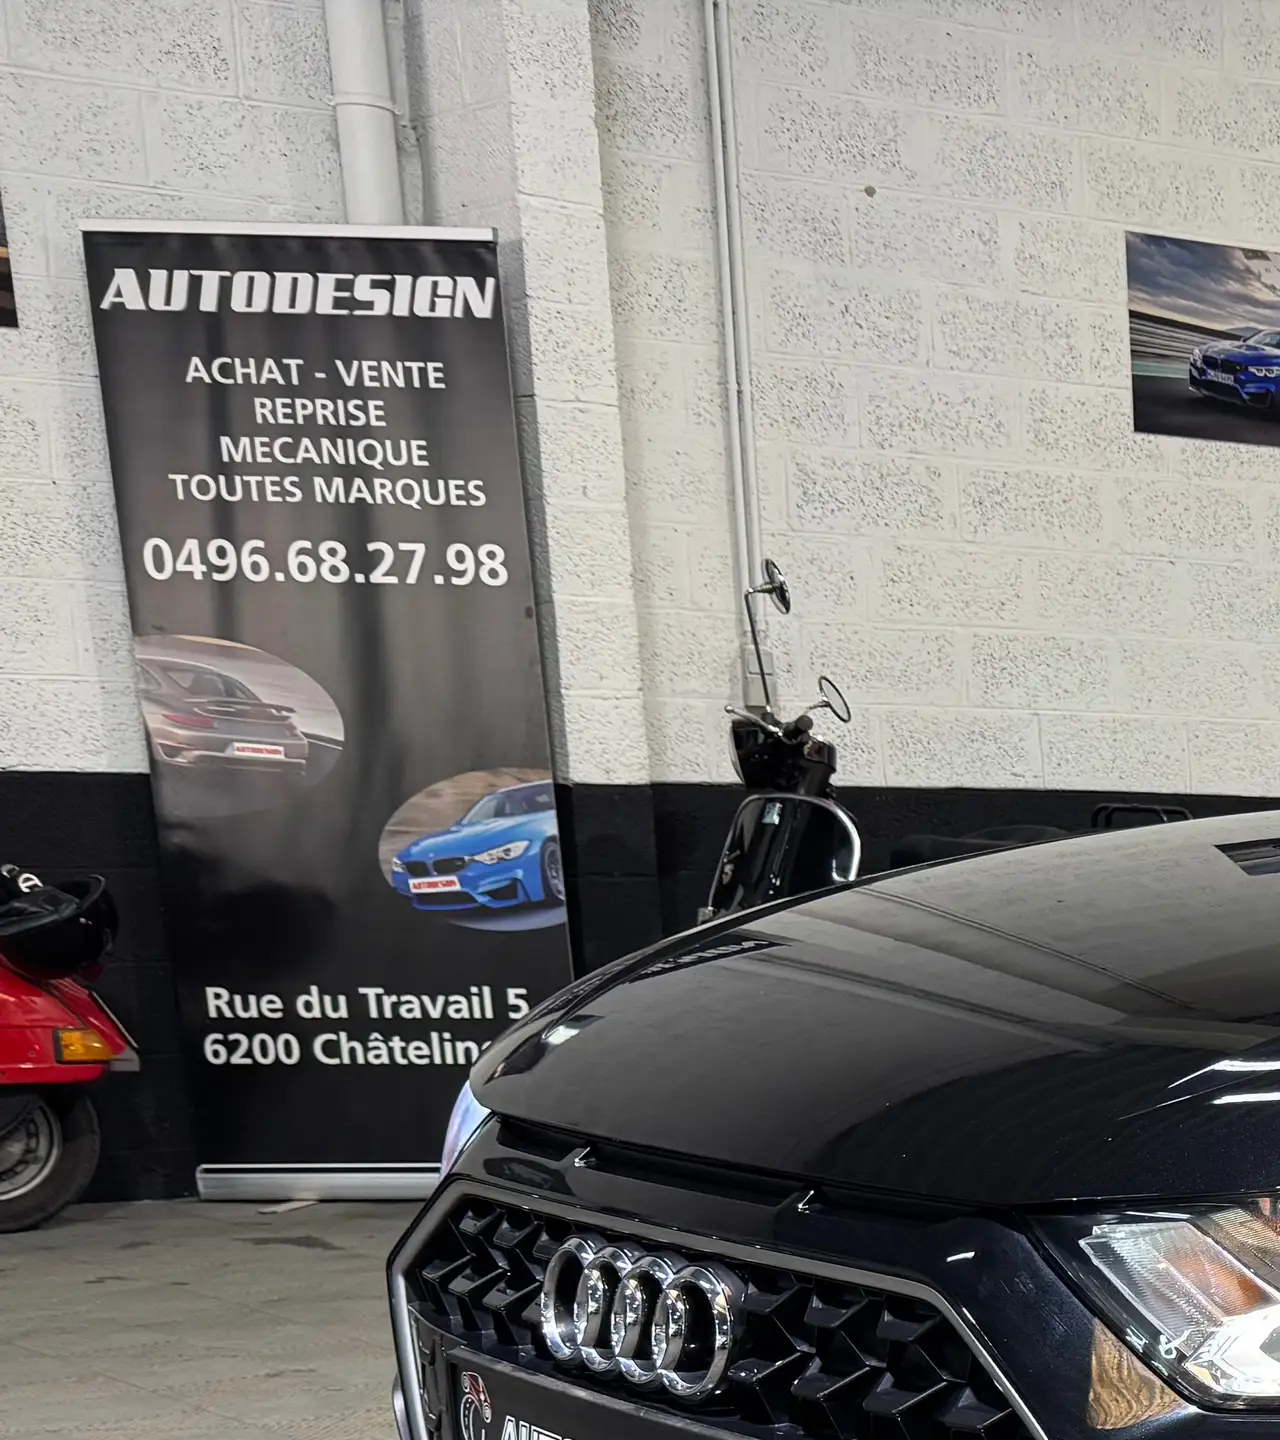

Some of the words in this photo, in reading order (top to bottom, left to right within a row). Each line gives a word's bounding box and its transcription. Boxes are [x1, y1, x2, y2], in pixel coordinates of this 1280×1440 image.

[100, 268, 496, 319] AUTODESIGN
[186, 356, 304, 385] ACHAT
[335, 360, 446, 390] VENTE
[254, 398, 387, 427] REPRISE
[219, 436, 431, 471] MECANIQUE
[168, 474, 303, 503] TOUTES
[313, 477, 487, 510] MARQUES
[143, 537, 509, 587] 0496.68.27.98
[204, 986, 284, 1019] Rue
[296, 985, 349, 1019] du
[358, 985, 494, 1019] Travail
[506, 988, 530, 1019] 5
[203, 1032, 300, 1065] 6200
